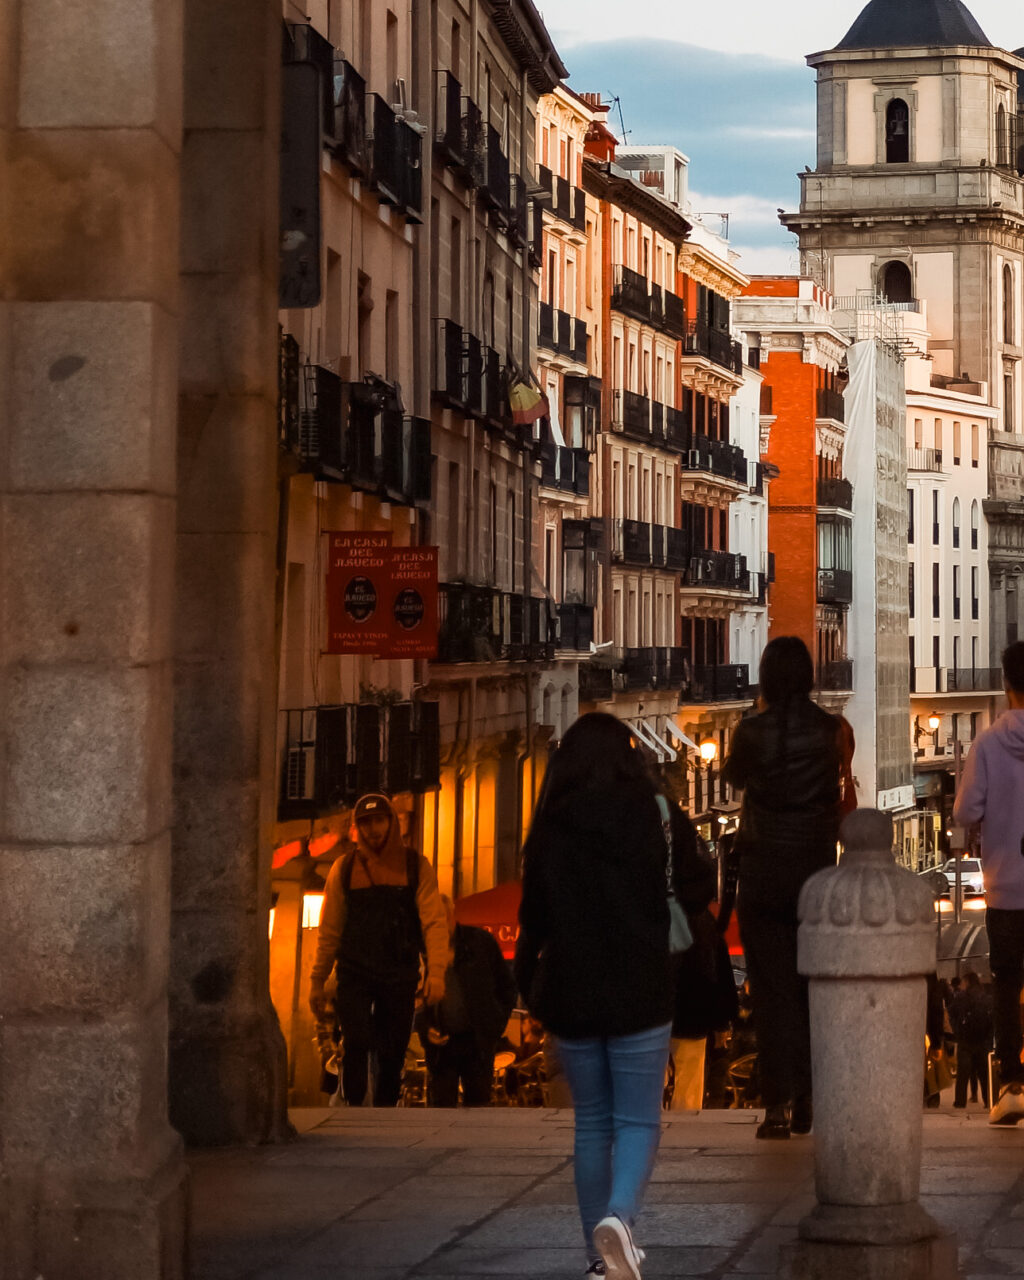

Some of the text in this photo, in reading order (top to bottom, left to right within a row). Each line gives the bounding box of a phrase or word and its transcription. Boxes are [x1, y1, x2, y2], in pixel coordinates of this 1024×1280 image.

[335, 537, 388, 548] LA CASA
[349, 548, 373, 558] DEL
[402, 552, 433, 562] CASA
[334, 558, 384, 568] ABUELO
